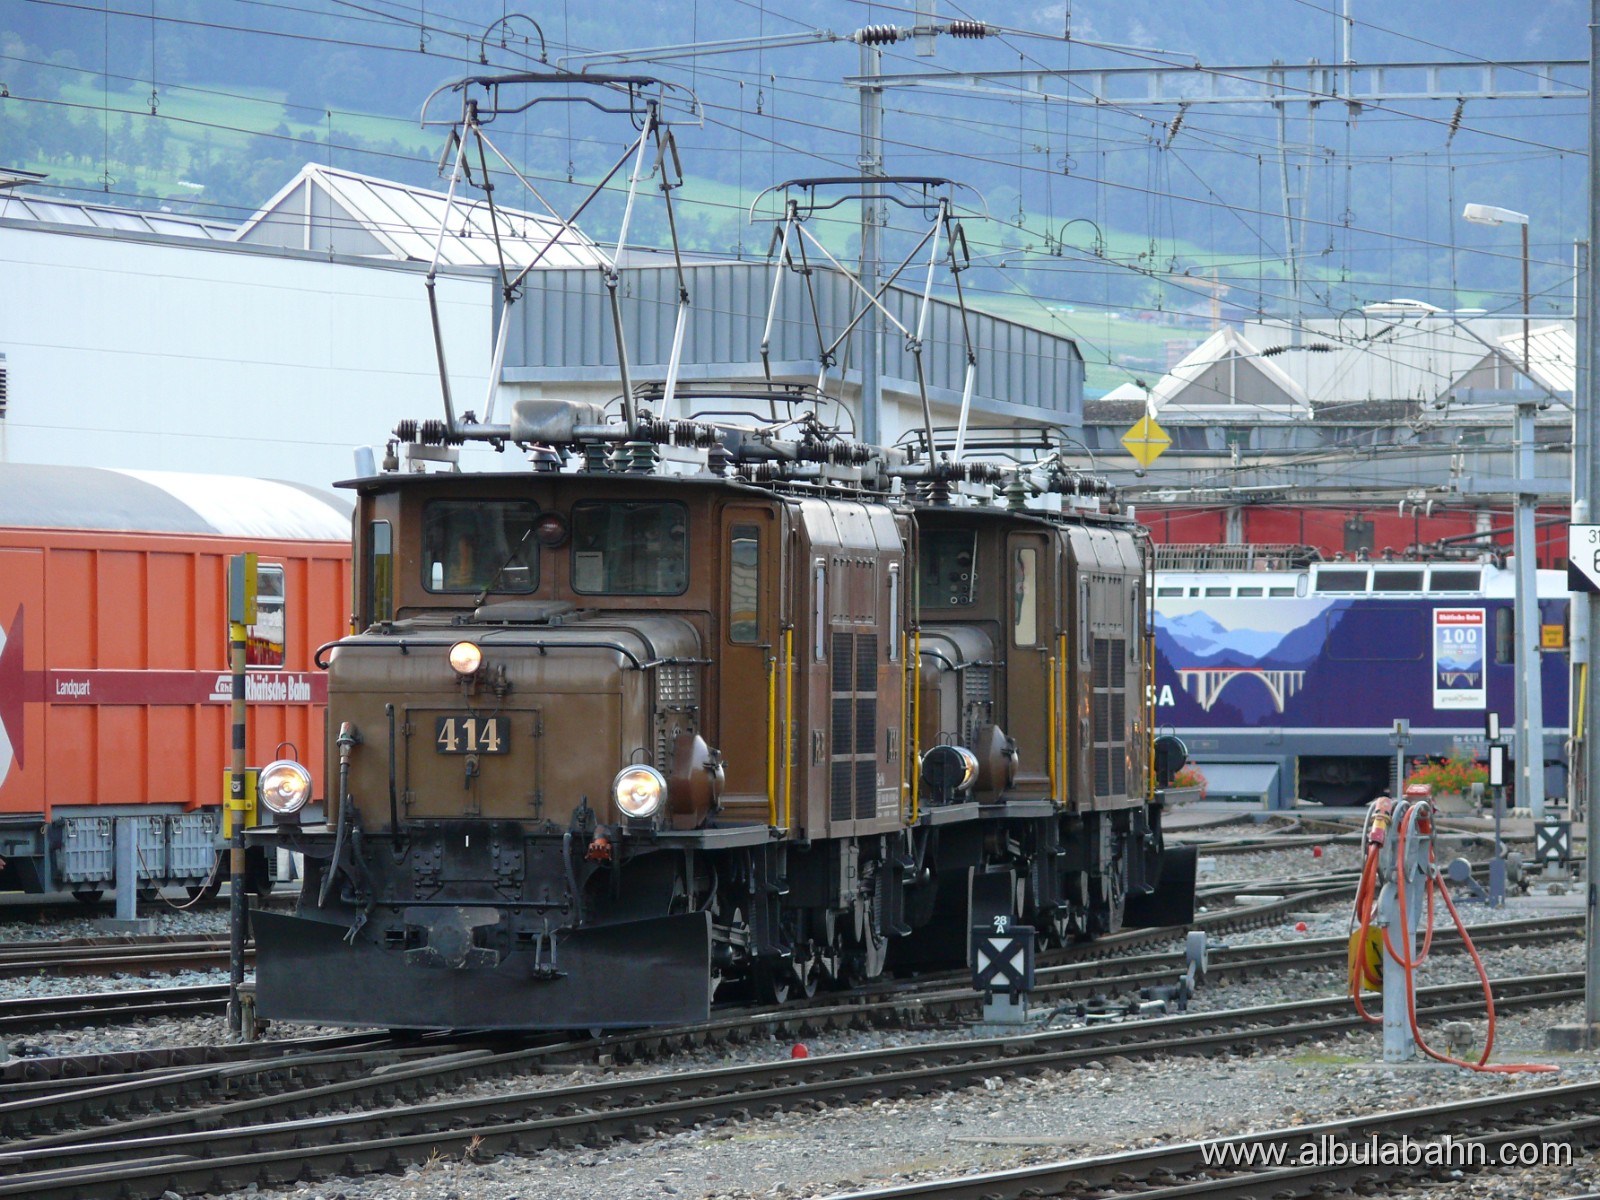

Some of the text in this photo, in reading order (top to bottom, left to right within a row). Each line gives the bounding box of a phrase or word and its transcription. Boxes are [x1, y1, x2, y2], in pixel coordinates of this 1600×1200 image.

[1442, 628, 1477, 643] 100
[56, 678, 90, 698] Landquart
[245, 674, 311, 701] Rhätische Bahn
[437, 718, 501, 751] 414
[993, 915, 1008, 926] 28
[996, 924, 1005, 934] A
